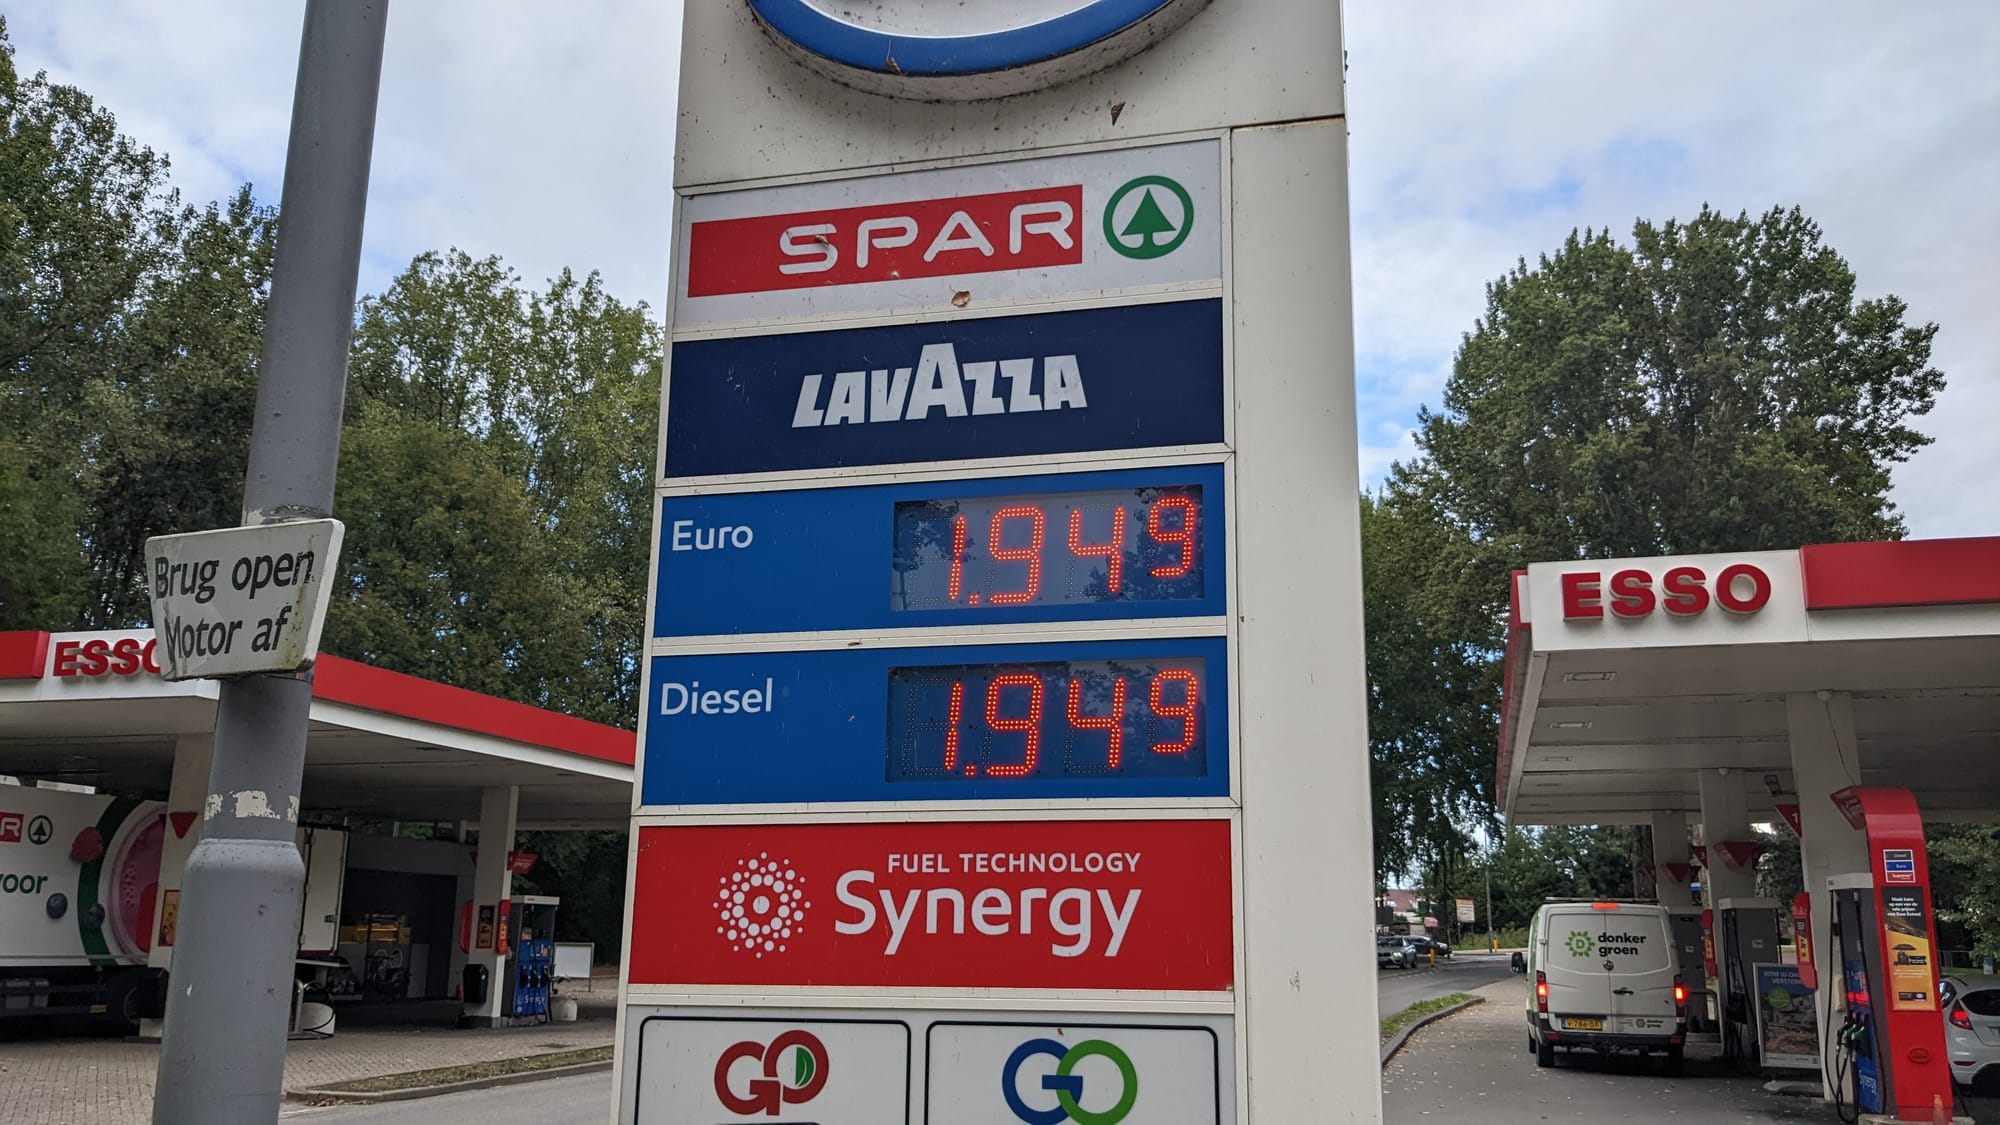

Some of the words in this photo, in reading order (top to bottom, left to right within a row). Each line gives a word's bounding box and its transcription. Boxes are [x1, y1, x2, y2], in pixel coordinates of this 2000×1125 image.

[778, 200, 1074, 275] SPAR
[791, 342, 1088, 428] LAVAZZA
[671, 519, 754, 552] Euro
[946, 495, 1199, 607] 1.949
[154, 557, 219, 604] Brug
[231, 550, 315, 600] open
[1561, 563, 1772, 622] ESSO
[164, 615, 243, 660] Motor
[251, 605, 292, 653] af
[660, 677, 773, 716] Diesel
[941, 668, 1200, 778] 1.949
[887, 853, 950, 874] FUEL
[959, 852, 1141, 874] TECHNOLOGY
[834, 869, 1142, 957] Synergy
[1597, 932, 1646, 944] donker
[1598, 946, 1639, 957] groen
[1002, 1038, 1138, 1125] GO
